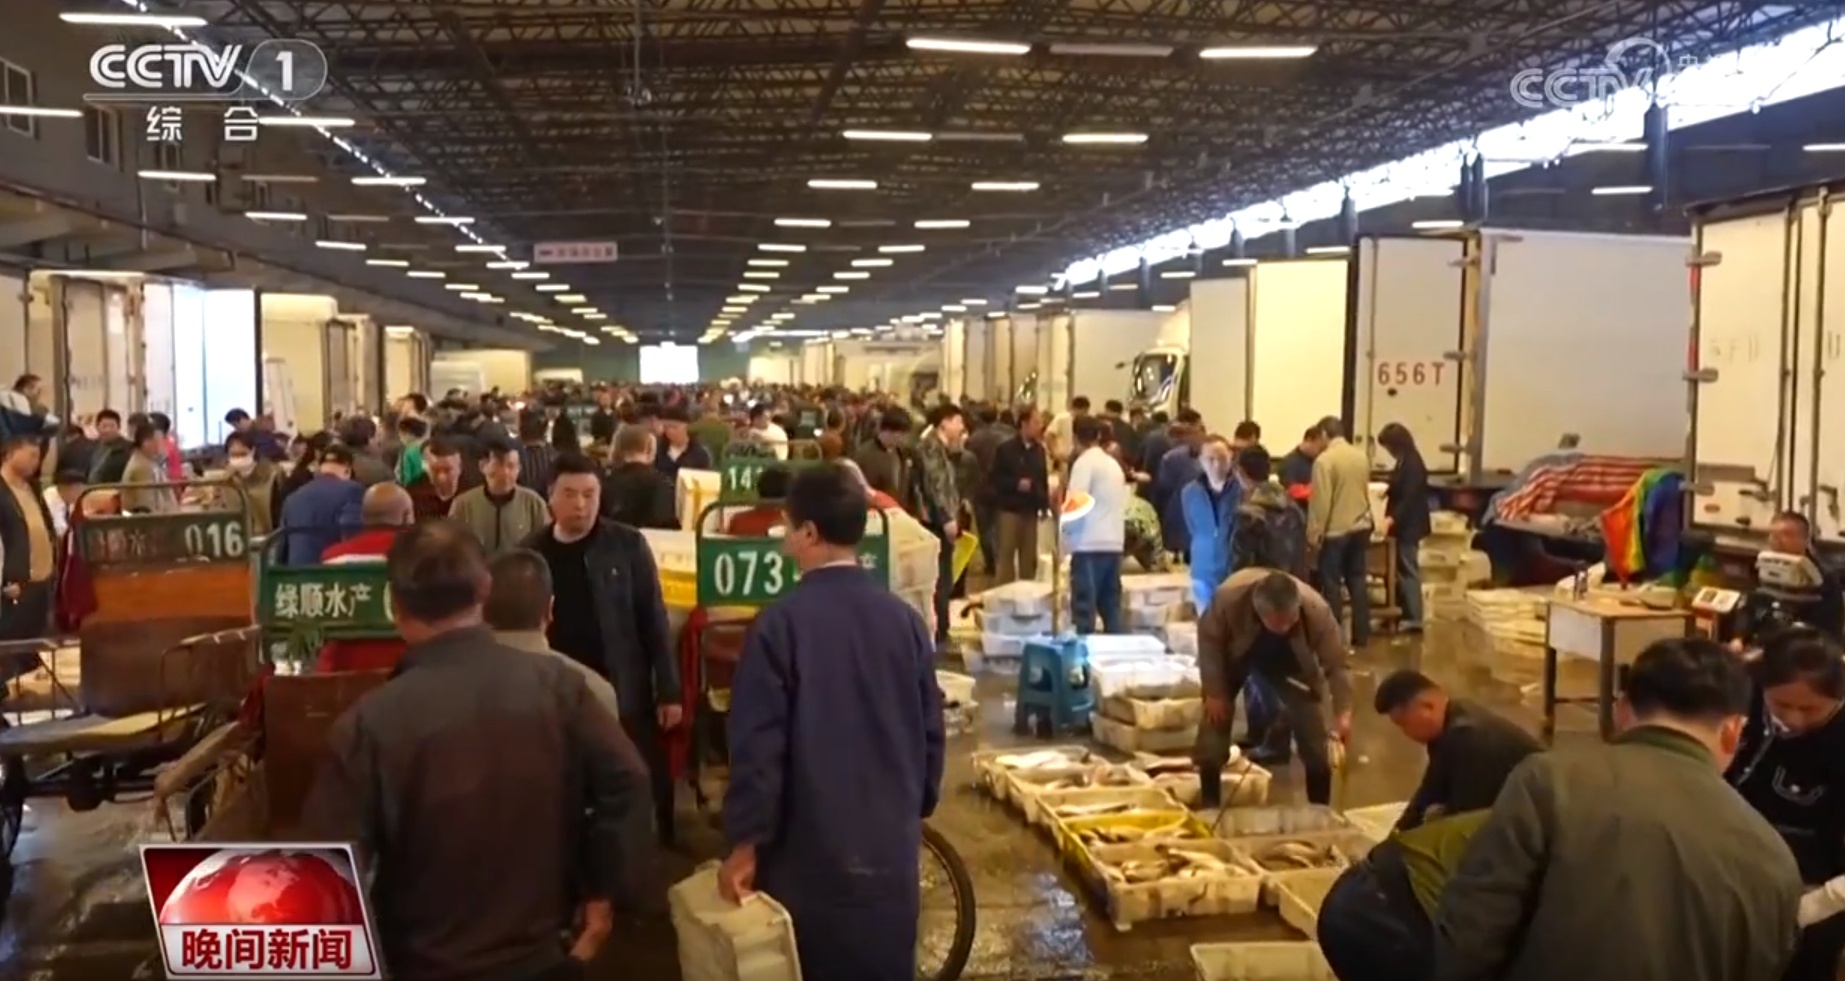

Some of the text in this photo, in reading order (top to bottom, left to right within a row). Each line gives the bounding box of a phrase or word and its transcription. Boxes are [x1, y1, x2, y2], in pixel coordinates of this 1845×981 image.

[1377, 361, 1445, 387] 656T
[184, 520, 244, 558] 016
[714, 550, 784, 596] 073
[274, 582, 373, 620] 绿顺水产
